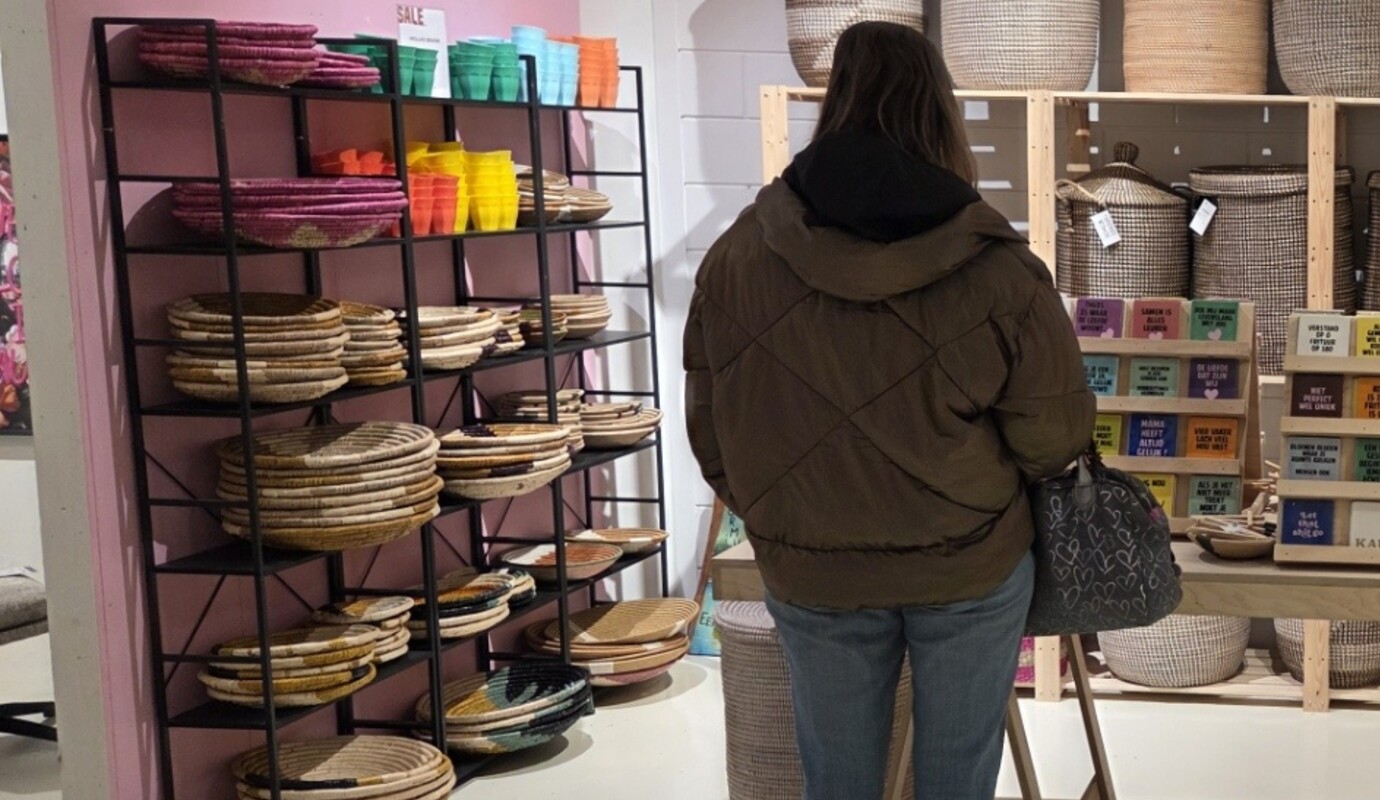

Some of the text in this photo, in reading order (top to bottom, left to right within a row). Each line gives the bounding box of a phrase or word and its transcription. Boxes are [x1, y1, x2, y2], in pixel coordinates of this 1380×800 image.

[397, 5, 426, 26] SALE
[1303, 394, 1332, 403] PERFECT
[1139, 439, 1164, 447] ALTIJD
